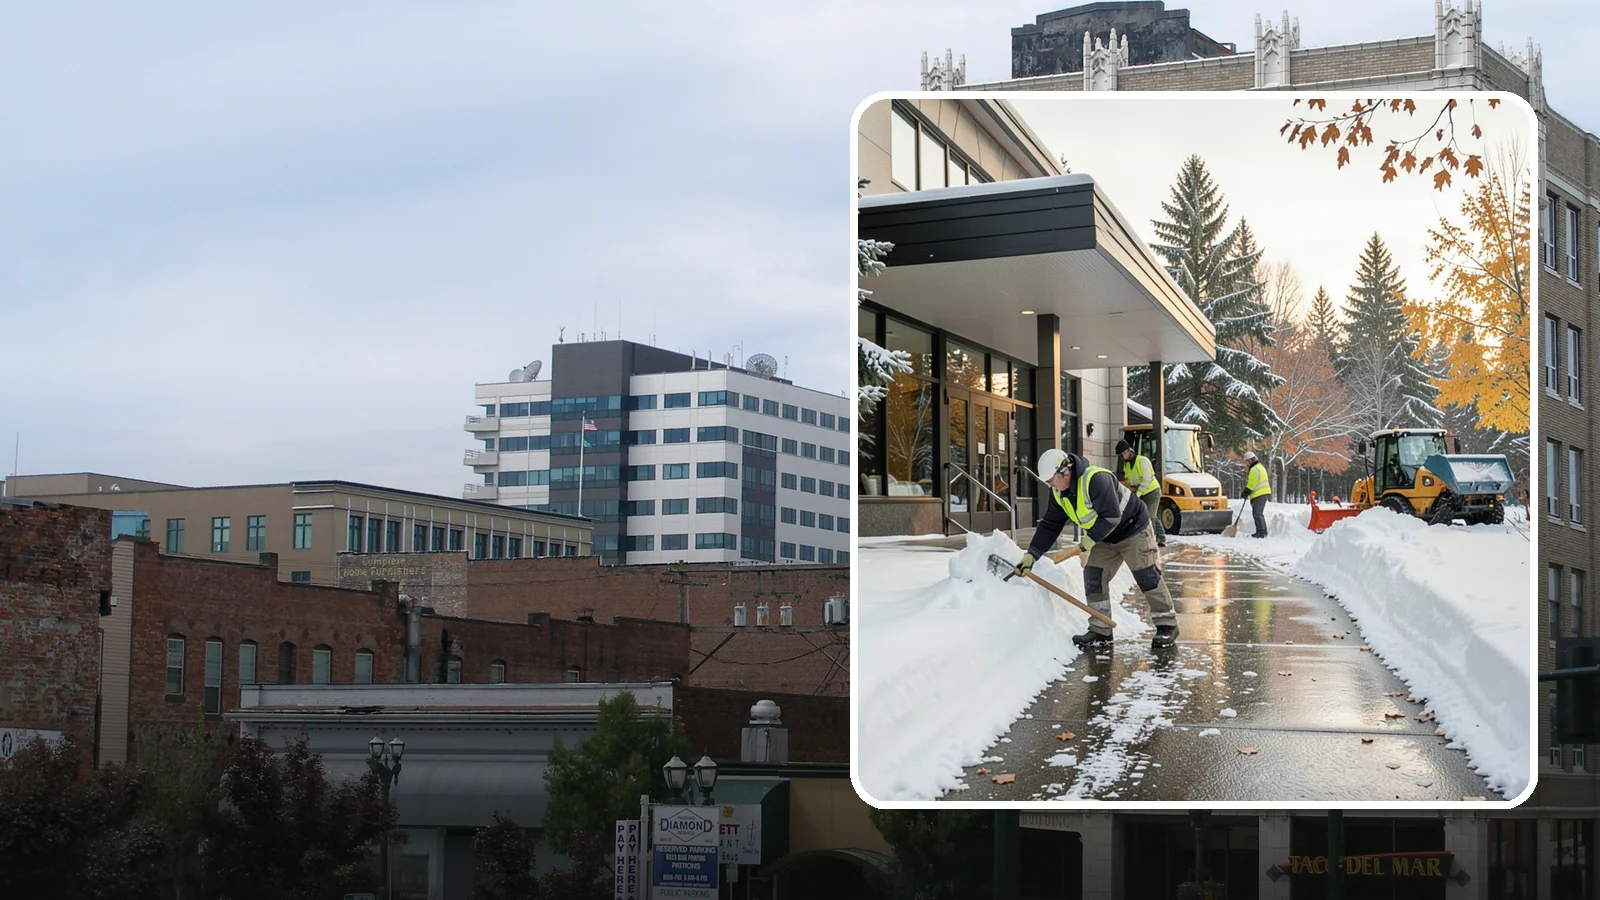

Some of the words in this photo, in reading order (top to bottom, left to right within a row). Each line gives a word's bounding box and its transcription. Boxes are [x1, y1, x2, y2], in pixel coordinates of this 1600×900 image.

[343, 568, 367, 577] Home
[370, 566, 427, 577] Furnishers
[660, 818, 713, 833] DIAMOND
[1021, 814, 1070, 828] BUILDING
[719, 824, 740, 835] ETT
[617, 825, 625, 852] PAY
[628, 824, 637, 852] PAY
[656, 845, 688, 853] RESERVED
[689, 846, 716, 854] PARKING
[721, 852, 739, 861] Soup
[671, 862, 701, 870] PATRONS
[1346, 856, 1385, 875] DEL
[1392, 857, 1442, 877] MAR
[616, 856, 625, 894] HERE
[627, 855, 636, 893] HERE
[660, 888, 682, 897] PUBLIC
[683, 889, 710, 898] PARKING
